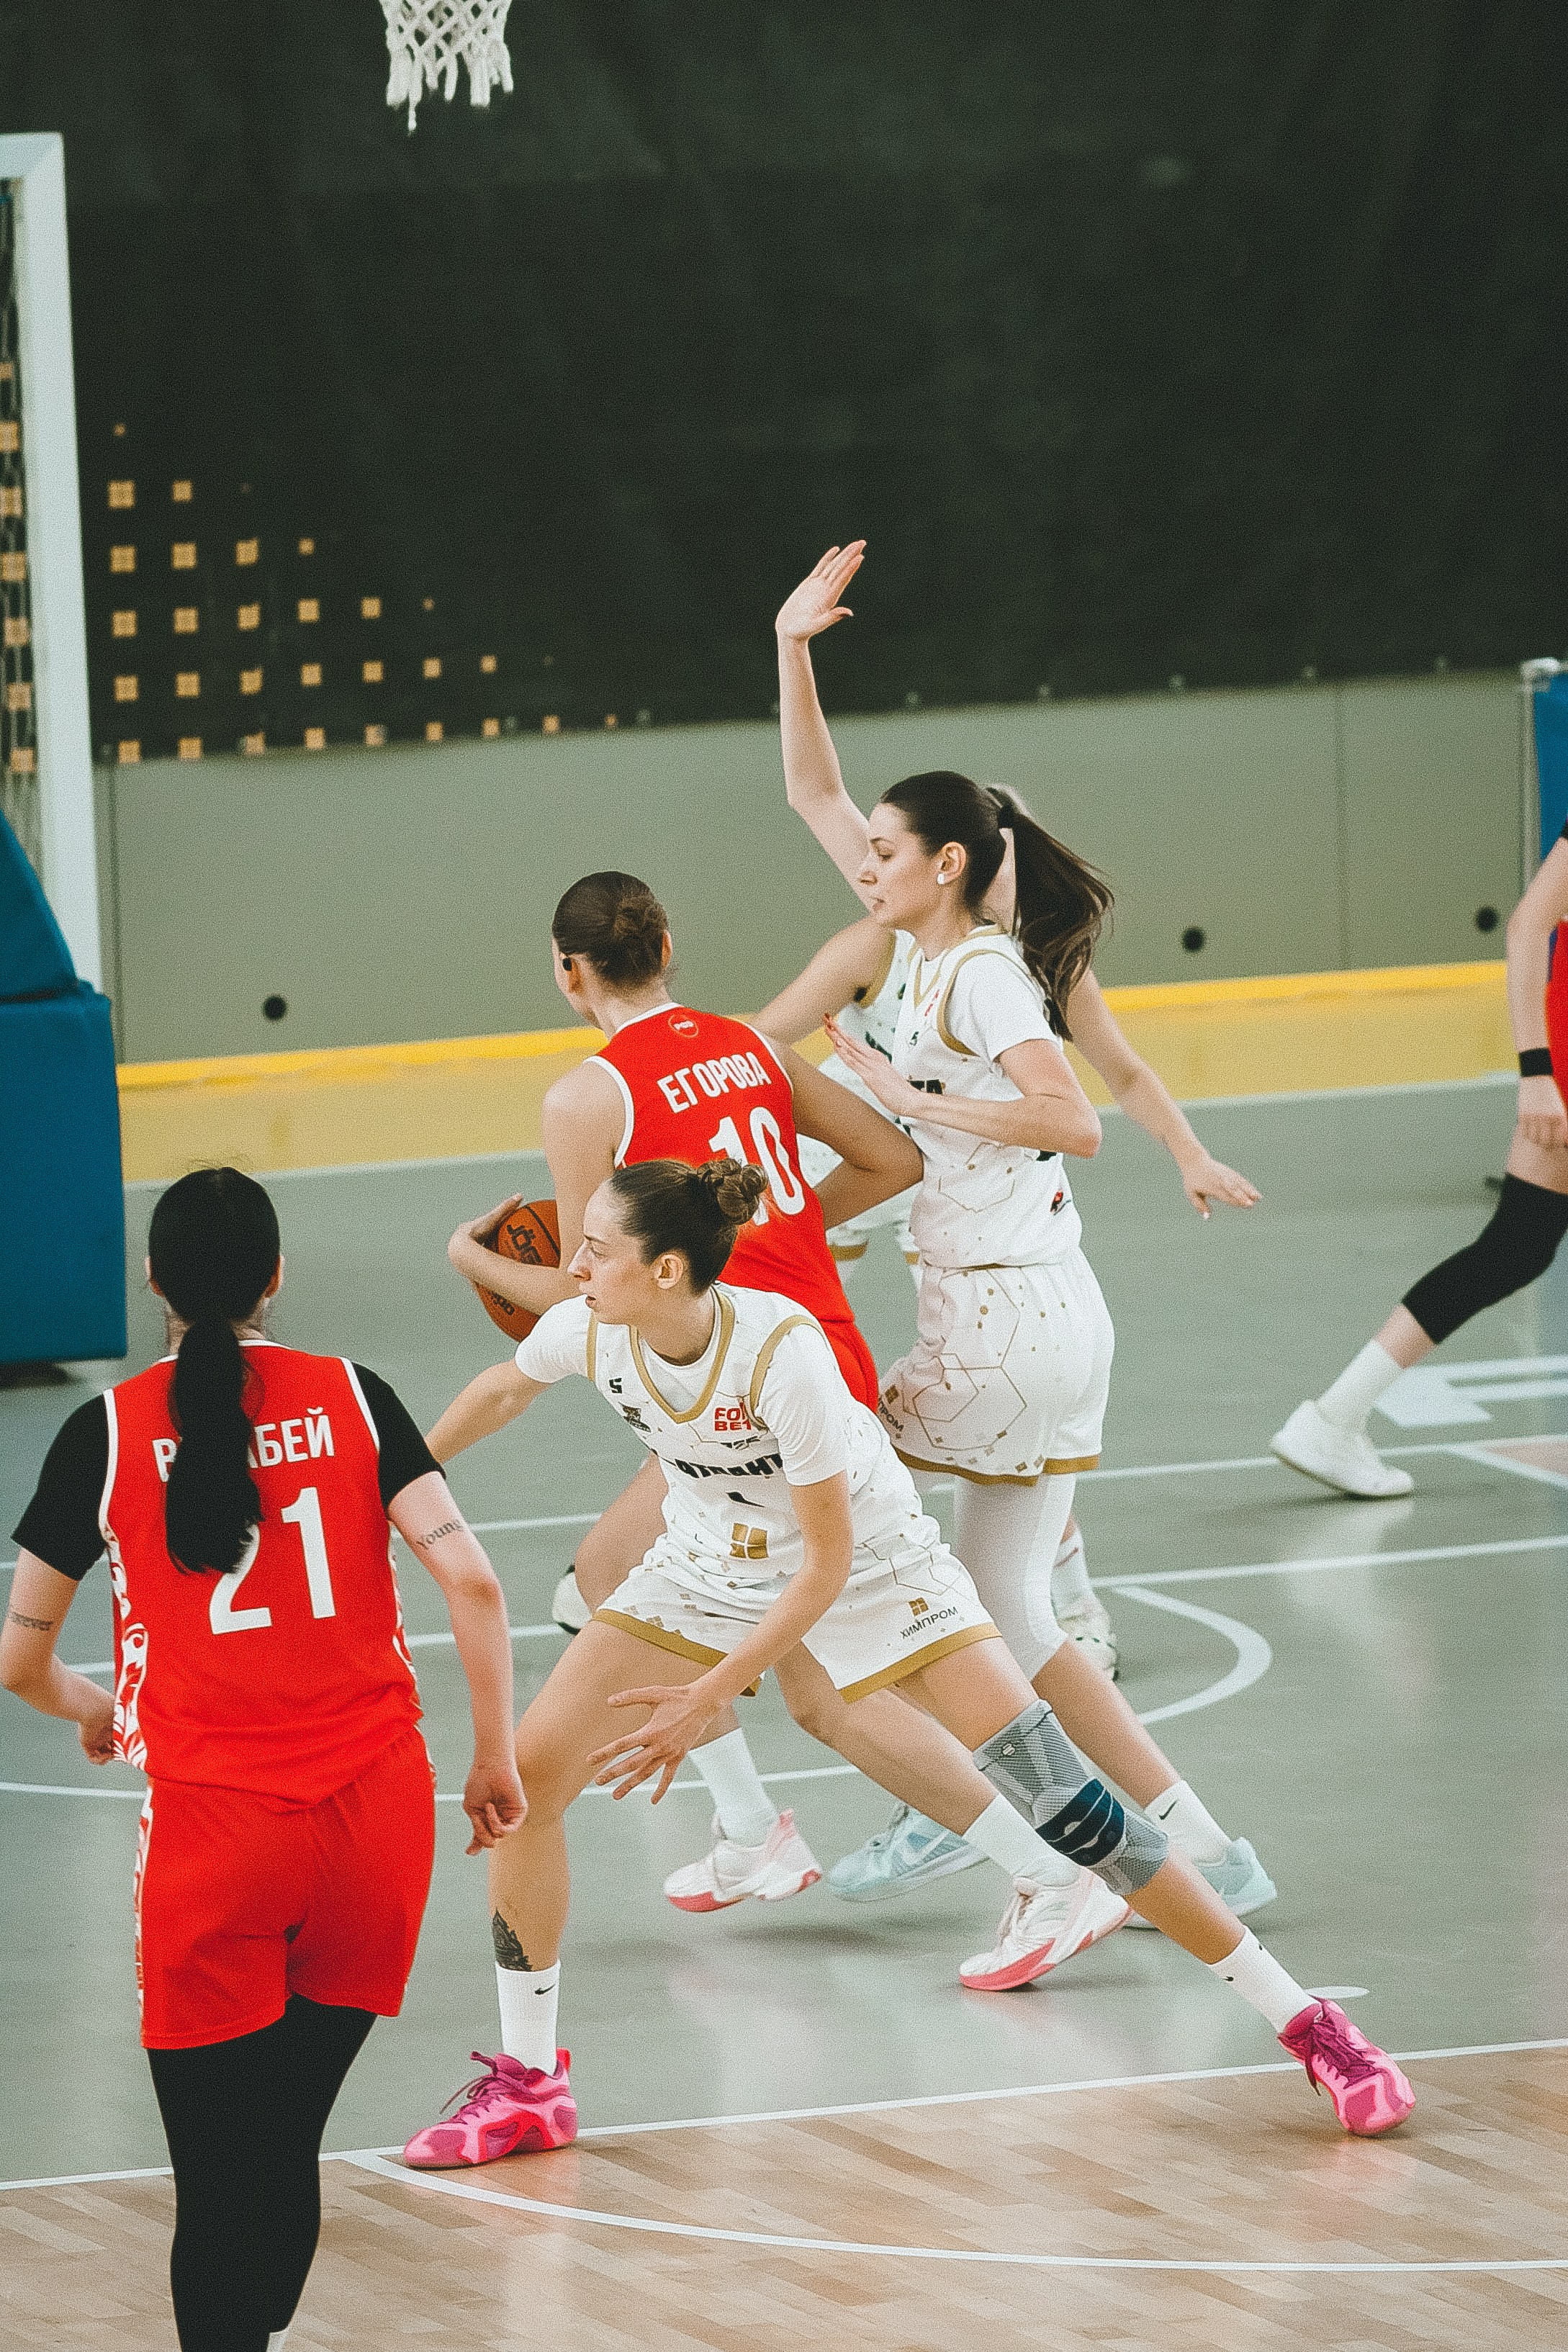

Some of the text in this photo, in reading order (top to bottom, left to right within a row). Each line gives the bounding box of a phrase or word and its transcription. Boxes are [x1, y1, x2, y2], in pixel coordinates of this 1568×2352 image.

[657, 1051, 771, 1113] ЕГОРОВА
[708, 1107, 805, 1225] 10
[209, 1487, 336, 1635] 21
[900, 1606, 958, 1639] ХИМПРОМ
